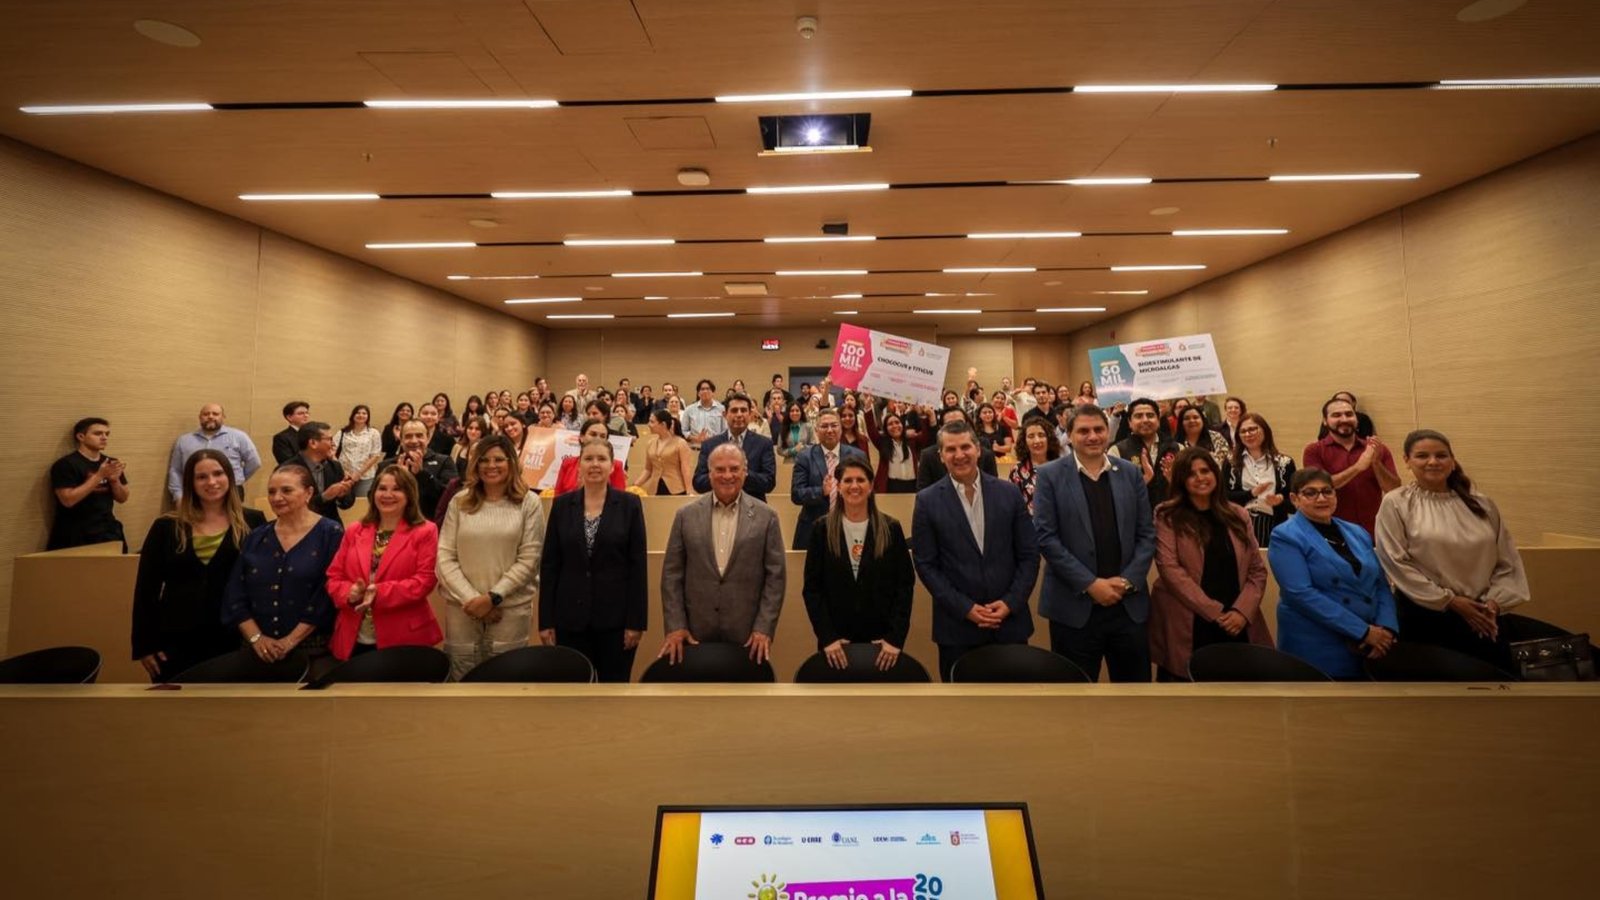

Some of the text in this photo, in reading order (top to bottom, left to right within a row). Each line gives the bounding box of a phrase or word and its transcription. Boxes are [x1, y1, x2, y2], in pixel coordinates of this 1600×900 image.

[841, 343, 866, 358] 100
[839, 353, 862, 368] MIL
[1138, 356, 1191, 367] BIOESTIMULANTE
[1101, 365, 1121, 377] 60
[1139, 364, 1180, 374] MICROALGAS
[1100, 374, 1126, 386] MIL
[524, 455, 545, 467] MIL
[915, 873, 943, 896] 20
[890, 888, 909, 900] la
